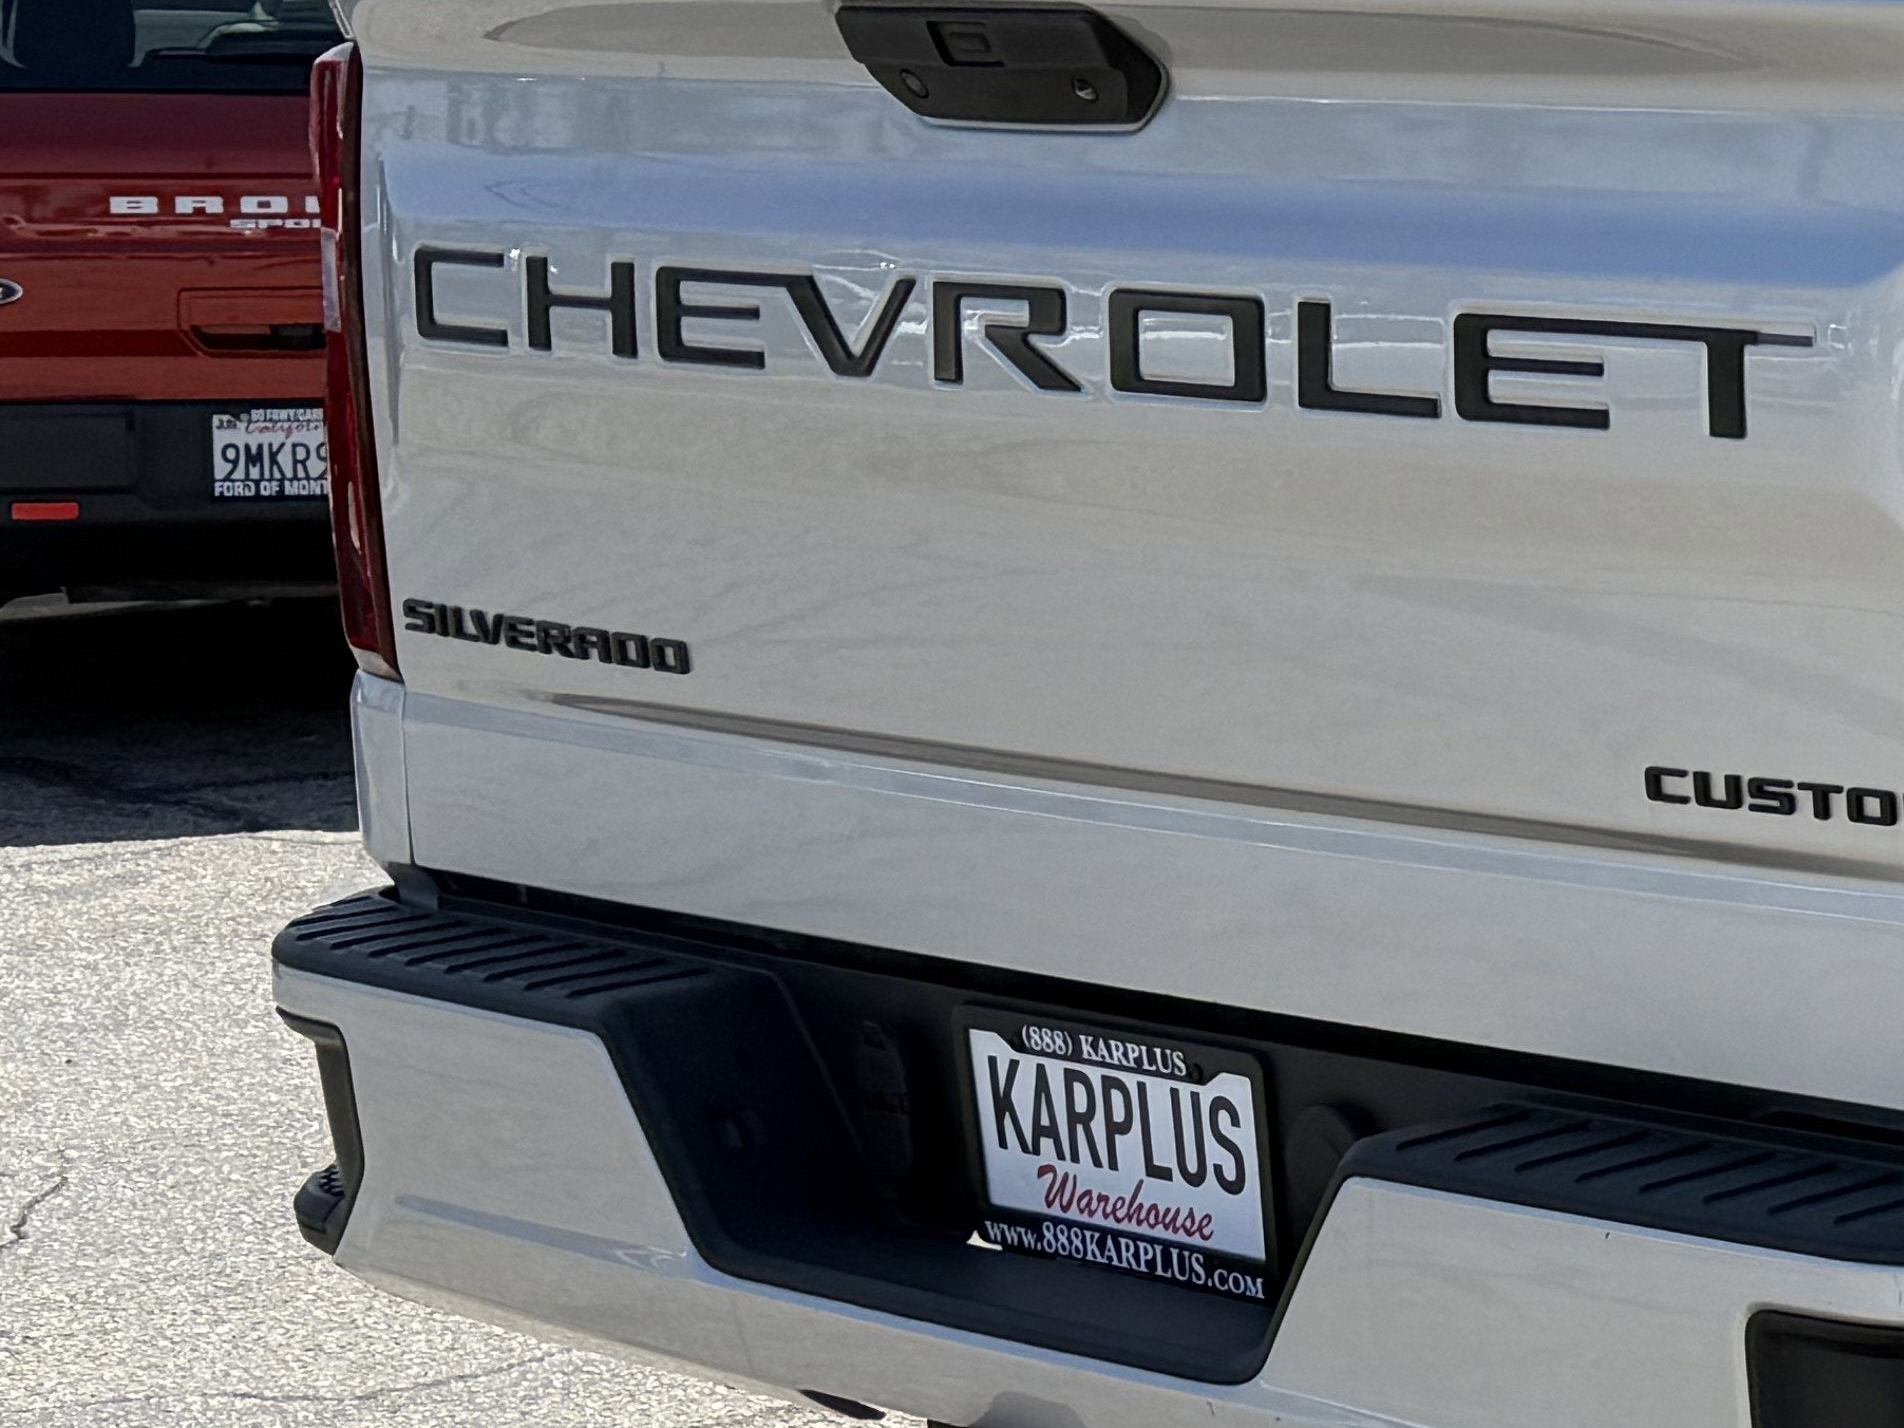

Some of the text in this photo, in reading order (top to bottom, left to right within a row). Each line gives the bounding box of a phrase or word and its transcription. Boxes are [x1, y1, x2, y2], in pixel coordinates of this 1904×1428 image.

[109, 196, 320, 214] BRO
[414, 244, 1813, 440] CHEVROLET
[214, 481, 255, 497] FORD
[260, 481, 280, 496] OF
[402, 597, 691, 676] SILVERADO
[1021, 1024, 1187, 1077] (888) KARPLUS
[987, 1054, 1247, 1196] KARPLUS
[1037, 1164, 1214, 1241] Warehouse
